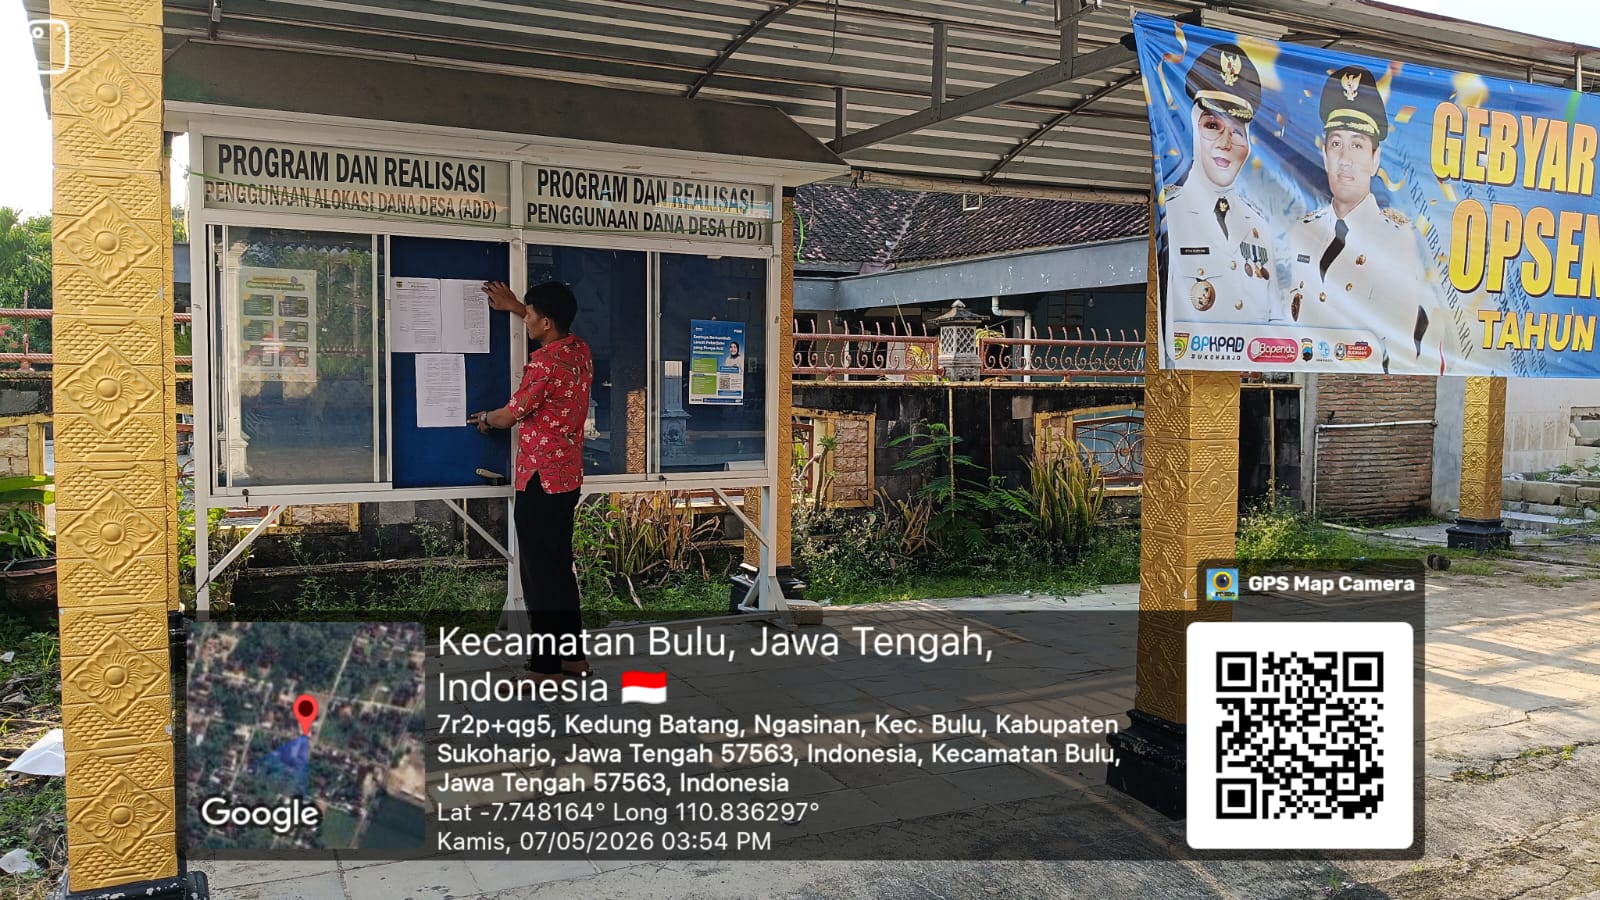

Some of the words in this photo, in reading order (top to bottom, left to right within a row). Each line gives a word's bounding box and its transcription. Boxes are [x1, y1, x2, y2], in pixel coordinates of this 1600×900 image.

[217, 142, 329, 182] PROGRAM
[335, 152, 378, 185] DAN
[384, 156, 486, 194] REALISASI
[1430, 101, 1598, 197] GEBYAR
[204, 180, 310, 209] PENGGUNAAN
[312, 187, 375, 212] ALOKASI
[379, 191, 416, 215] DANA
[418, 194, 456, 218] DESA
[457, 196, 498, 222] (ADD)
[536, 168, 628, 204] PROGRAM
[632, 177, 668, 207] DAN
[672, 181, 755, 211] REALISASI
[527, 202, 639, 231] PENGGUNAAN
[643, 210, 685, 235] DANA
[688, 215, 727, 238] DESA
[729, 218, 763, 241] (DD)
[1190, 335, 1245, 353] BPKPAD
[1259, 342, 1297, 356] Bapenda
[1477, 309, 1598, 352] TAHUN
[1190, 353, 1241, 361] SUKOHARJO
